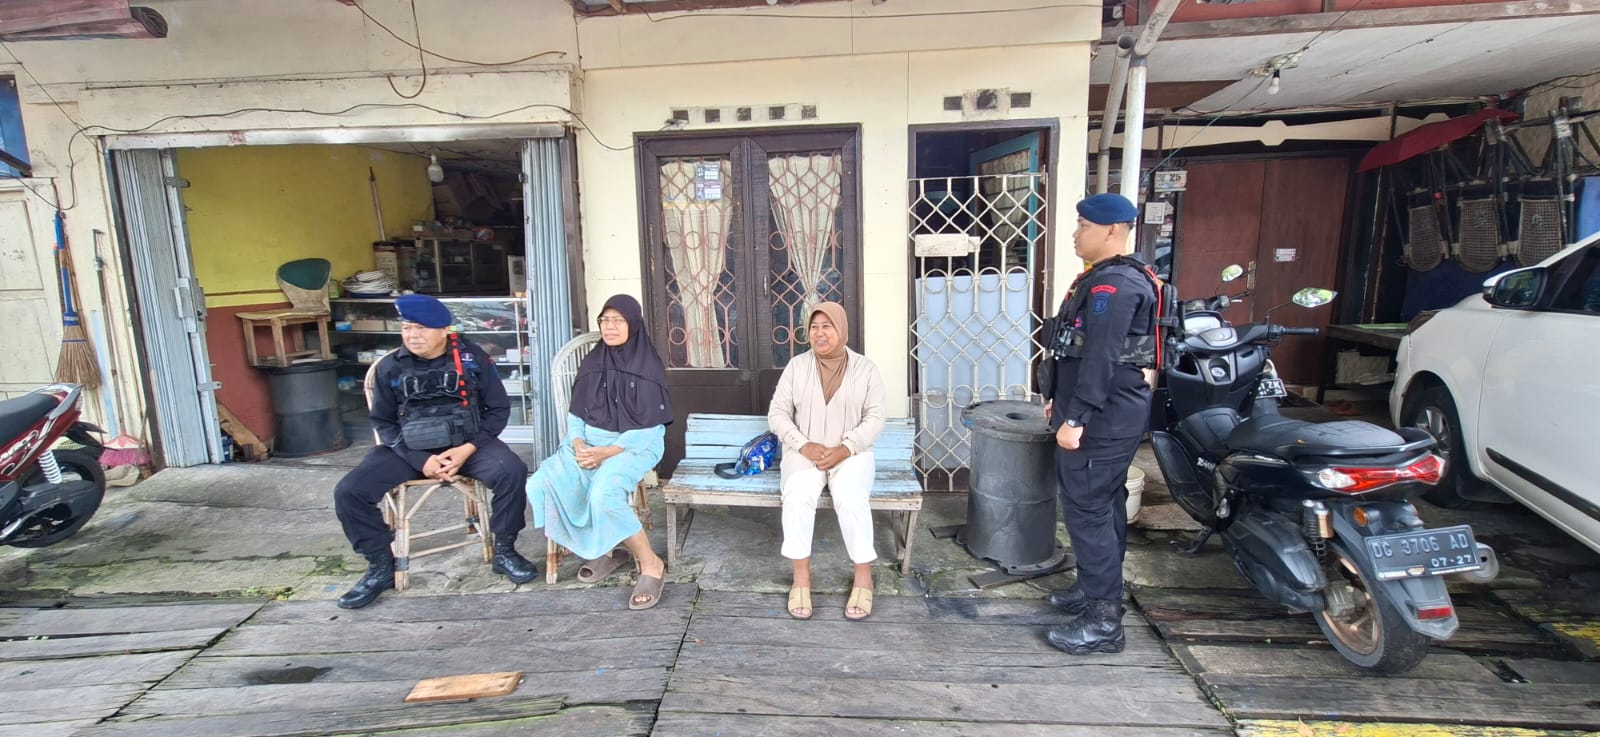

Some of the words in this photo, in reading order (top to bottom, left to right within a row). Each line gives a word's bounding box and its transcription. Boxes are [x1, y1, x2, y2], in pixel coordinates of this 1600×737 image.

[1372, 541, 1392, 558] DG
[1401, 536, 1440, 554] 3706
[1450, 533, 1469, 550] AD
